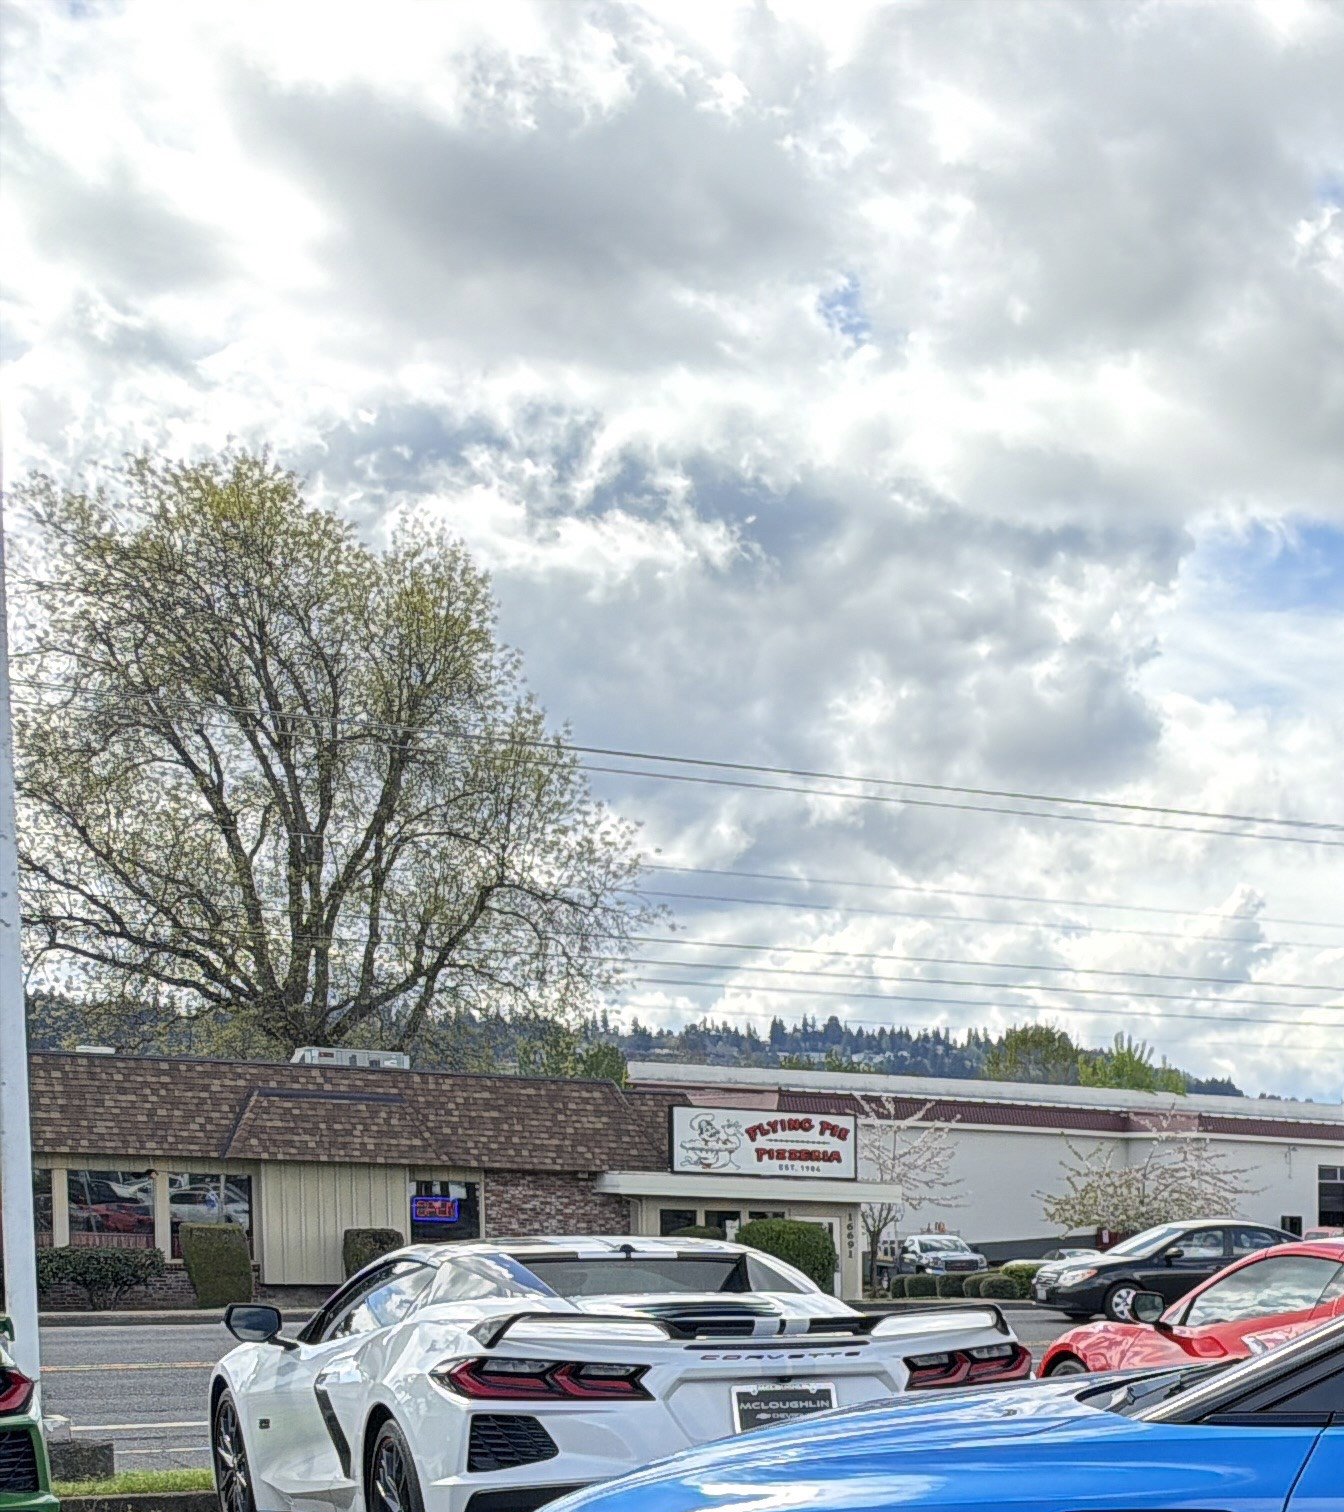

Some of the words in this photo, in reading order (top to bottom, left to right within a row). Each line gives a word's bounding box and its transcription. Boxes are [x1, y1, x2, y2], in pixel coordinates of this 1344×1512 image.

[745, 1117, 815, 1143] FLYING
[818, 1119, 851, 1142] PIE
[754, 1147, 843, 1164] PIZZERIA
[700, 1351, 861, 1360] CORVETTE
[739, 1399, 830, 1410] MCLOUGHLIN
